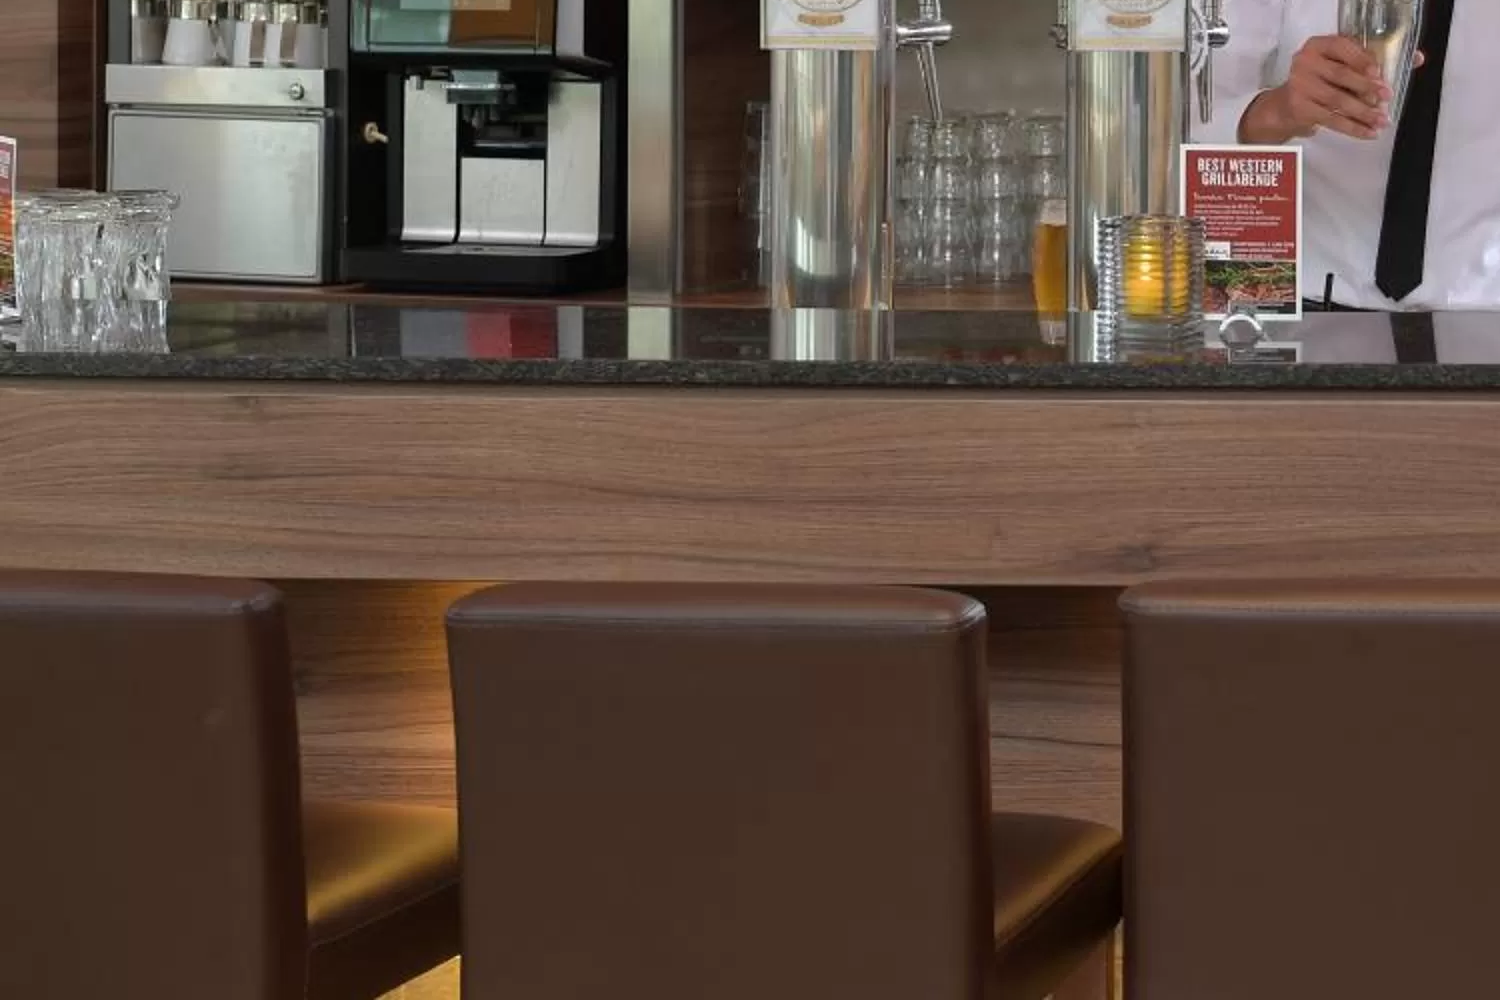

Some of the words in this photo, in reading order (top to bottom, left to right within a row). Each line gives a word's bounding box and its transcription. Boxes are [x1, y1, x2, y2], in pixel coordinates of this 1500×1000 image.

[1197, 157, 1226, 173] BEST
[1229, 158, 1283, 174] WESTERN
[1201, 171, 1279, 187] GRILLABENDE
